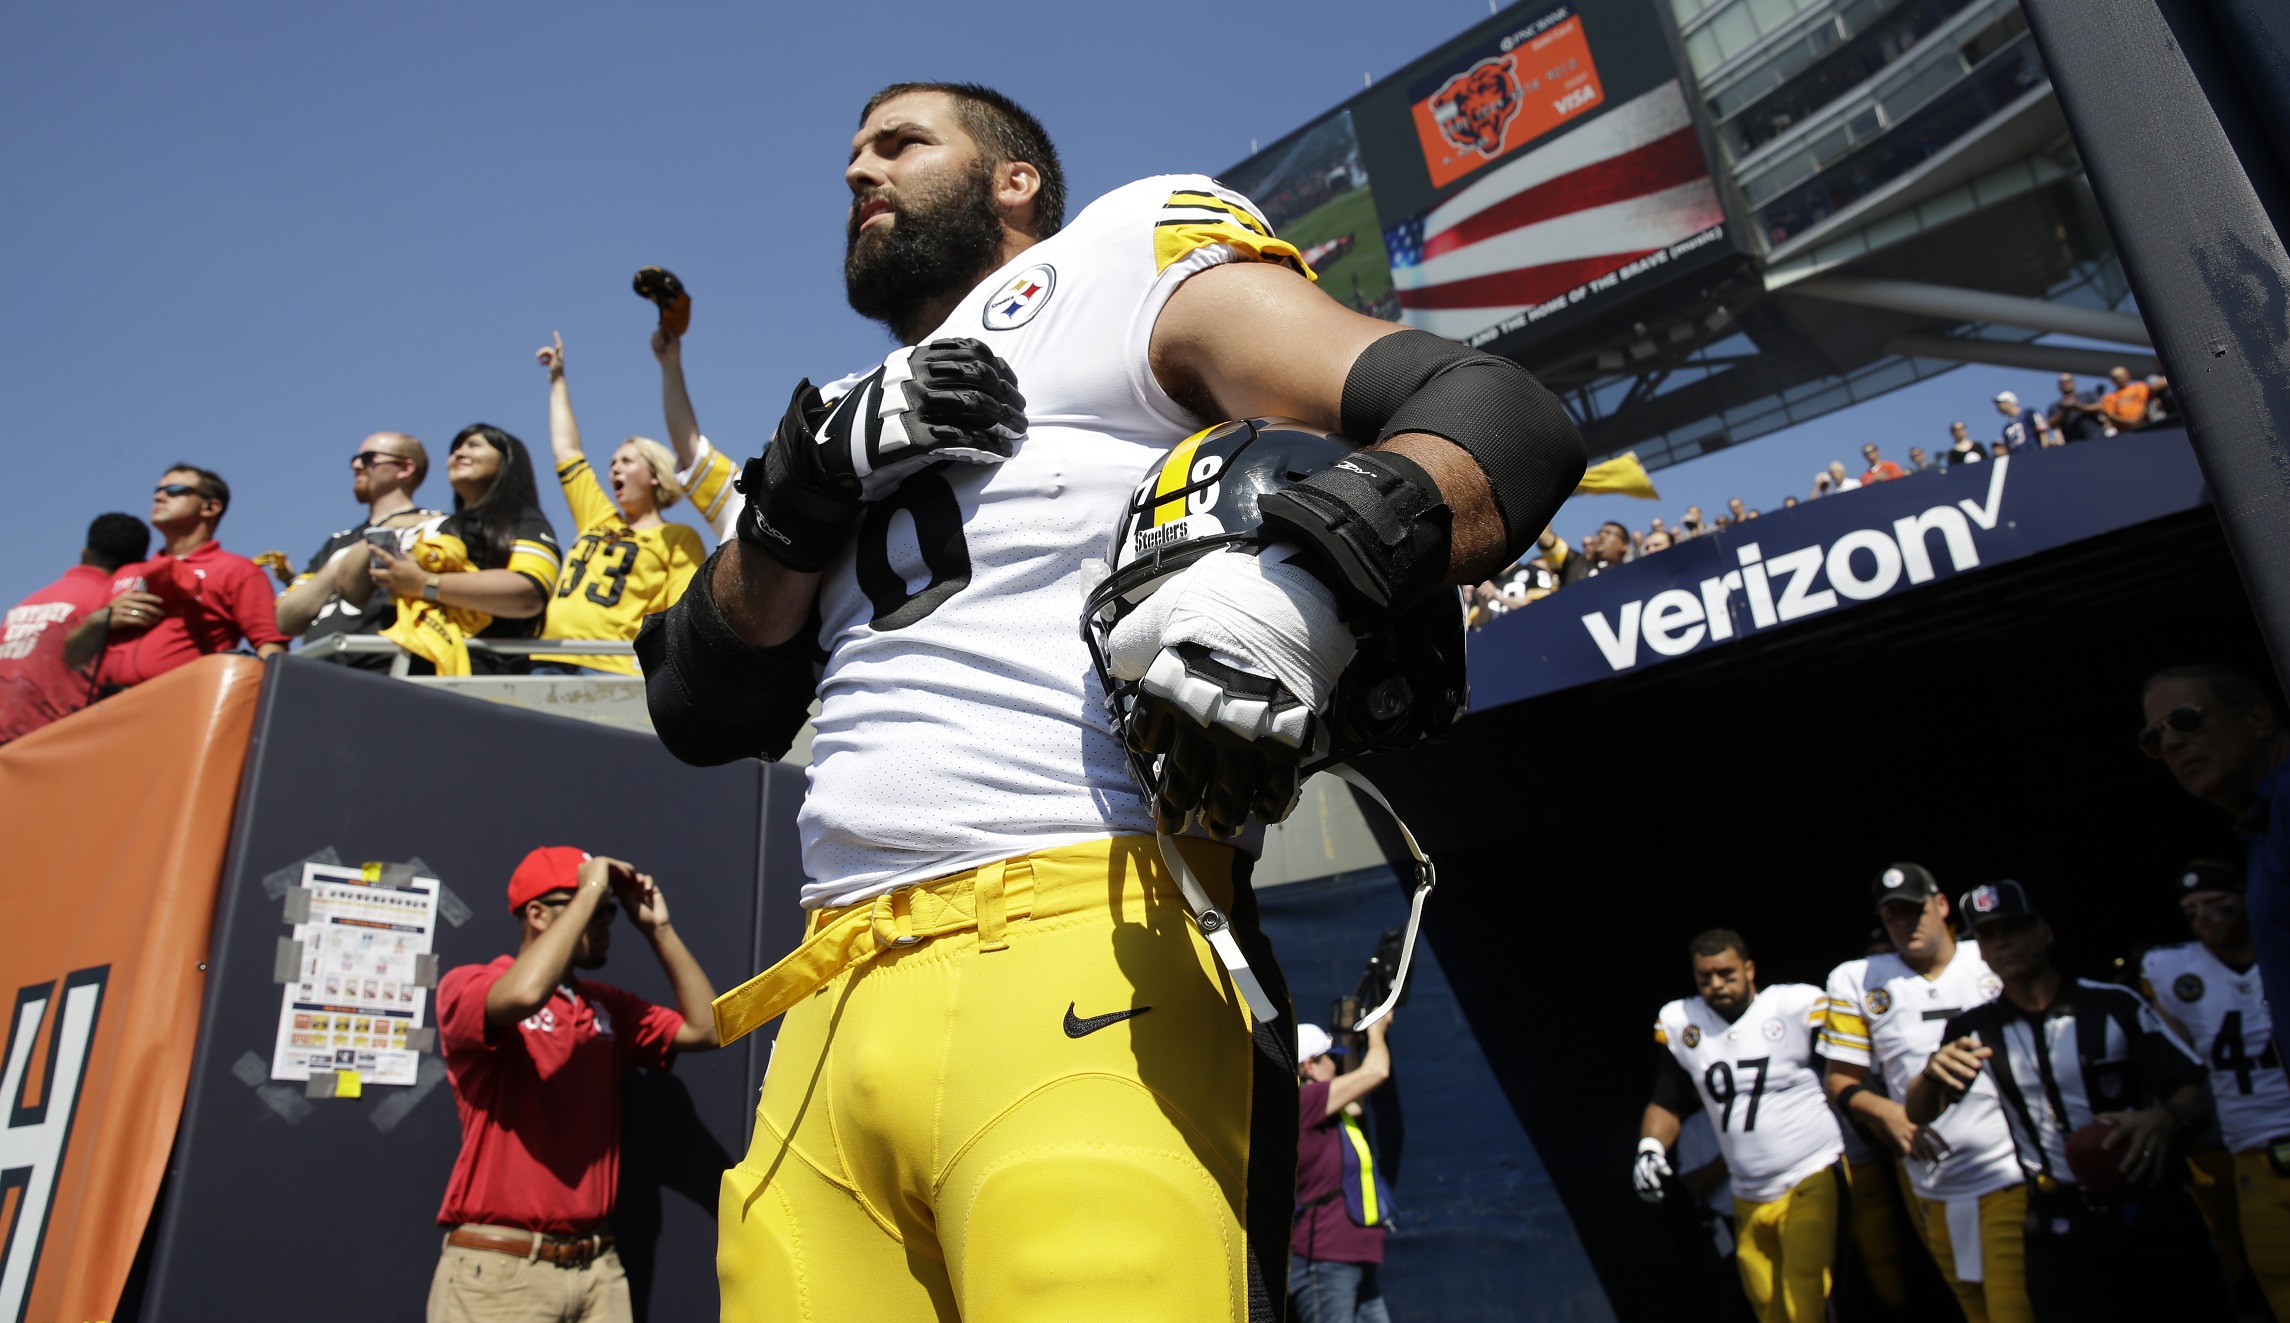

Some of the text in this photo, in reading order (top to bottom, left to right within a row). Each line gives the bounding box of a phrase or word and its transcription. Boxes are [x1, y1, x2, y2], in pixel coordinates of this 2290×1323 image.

[1535, 5, 1568, 32] BANK
[1552, 84, 1597, 115] VISA
[1471, 224, 1723, 350] AND THE HOME OF THE BRAVE (music)
[557, 534, 640, 608] 33
[1134, 521, 1188, 553] Steelers
[1581, 504, 1981, 671] verizon
[1705, 1057, 1771, 1133] 97
